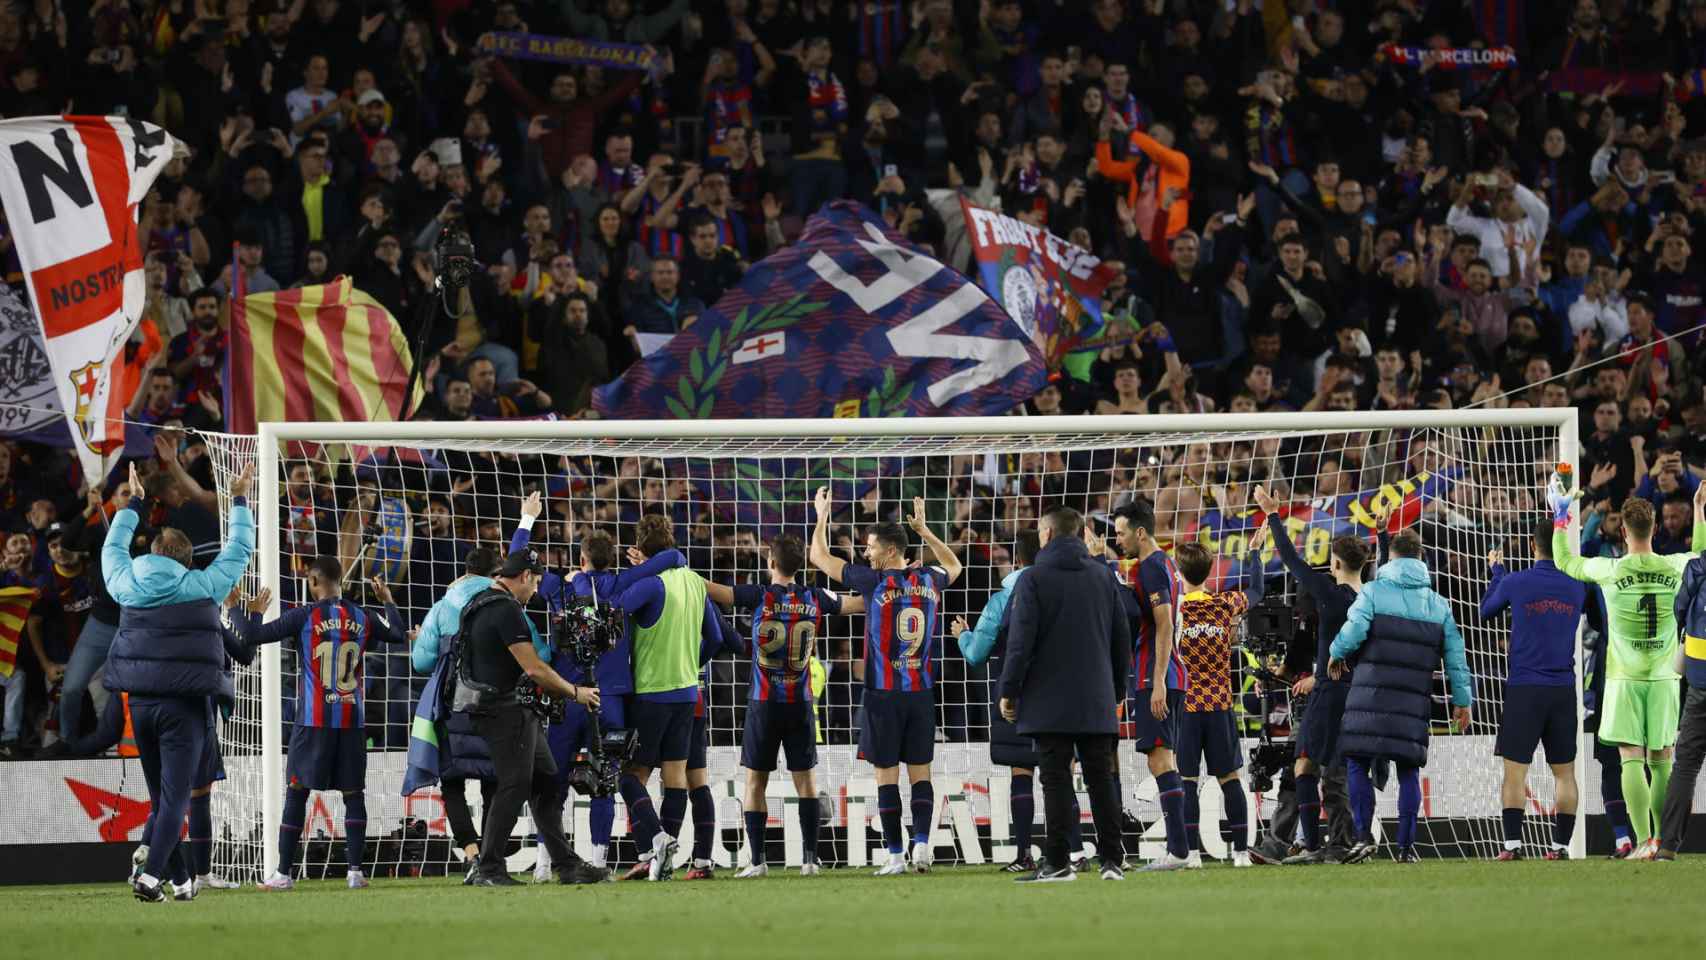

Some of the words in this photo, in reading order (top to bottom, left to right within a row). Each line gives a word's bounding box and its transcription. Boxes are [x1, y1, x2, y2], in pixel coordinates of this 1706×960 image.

[968, 207, 1042, 254] FRONT
[1615, 575, 1635, 590] TER
[1636, 572, 1678, 590] STEGEN
[314, 619, 342, 636] ANSU
[762, 605, 774, 617] S.
[774, 602, 817, 616] ROBERTO
[896, 607, 925, 657] 9
[1636, 593, 1657, 639] 1
[312, 641, 360, 691] 10
[757, 620, 817, 670] 20
